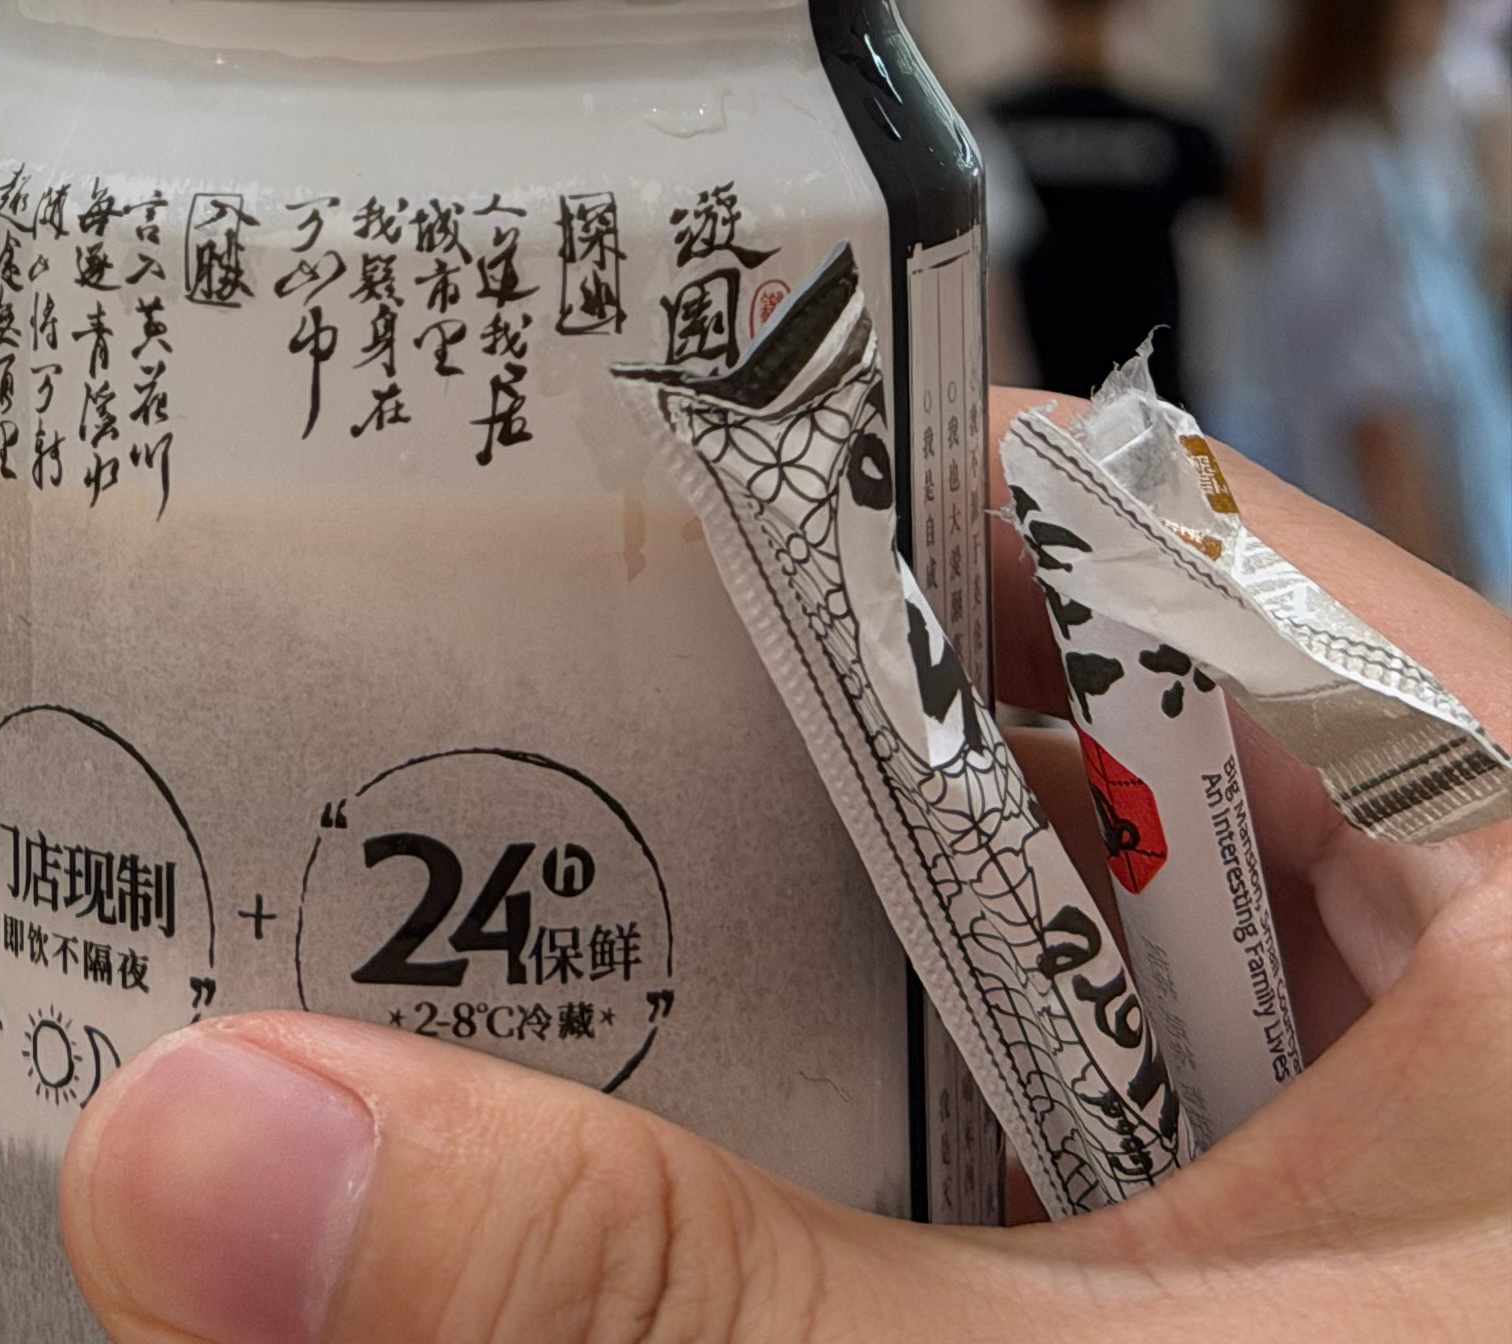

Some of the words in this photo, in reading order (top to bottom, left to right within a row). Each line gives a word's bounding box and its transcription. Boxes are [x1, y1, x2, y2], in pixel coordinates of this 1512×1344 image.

[1201, 773, 1224, 810] An
[1223, 753, 1240, 803] Big
[1211, 807, 1257, 944] Interesting
[3, 913, 151, 994] 即饮不隔夜
[1245, 941, 1278, 1018] Family
[1263, 1014, 1291, 1085] Lives
